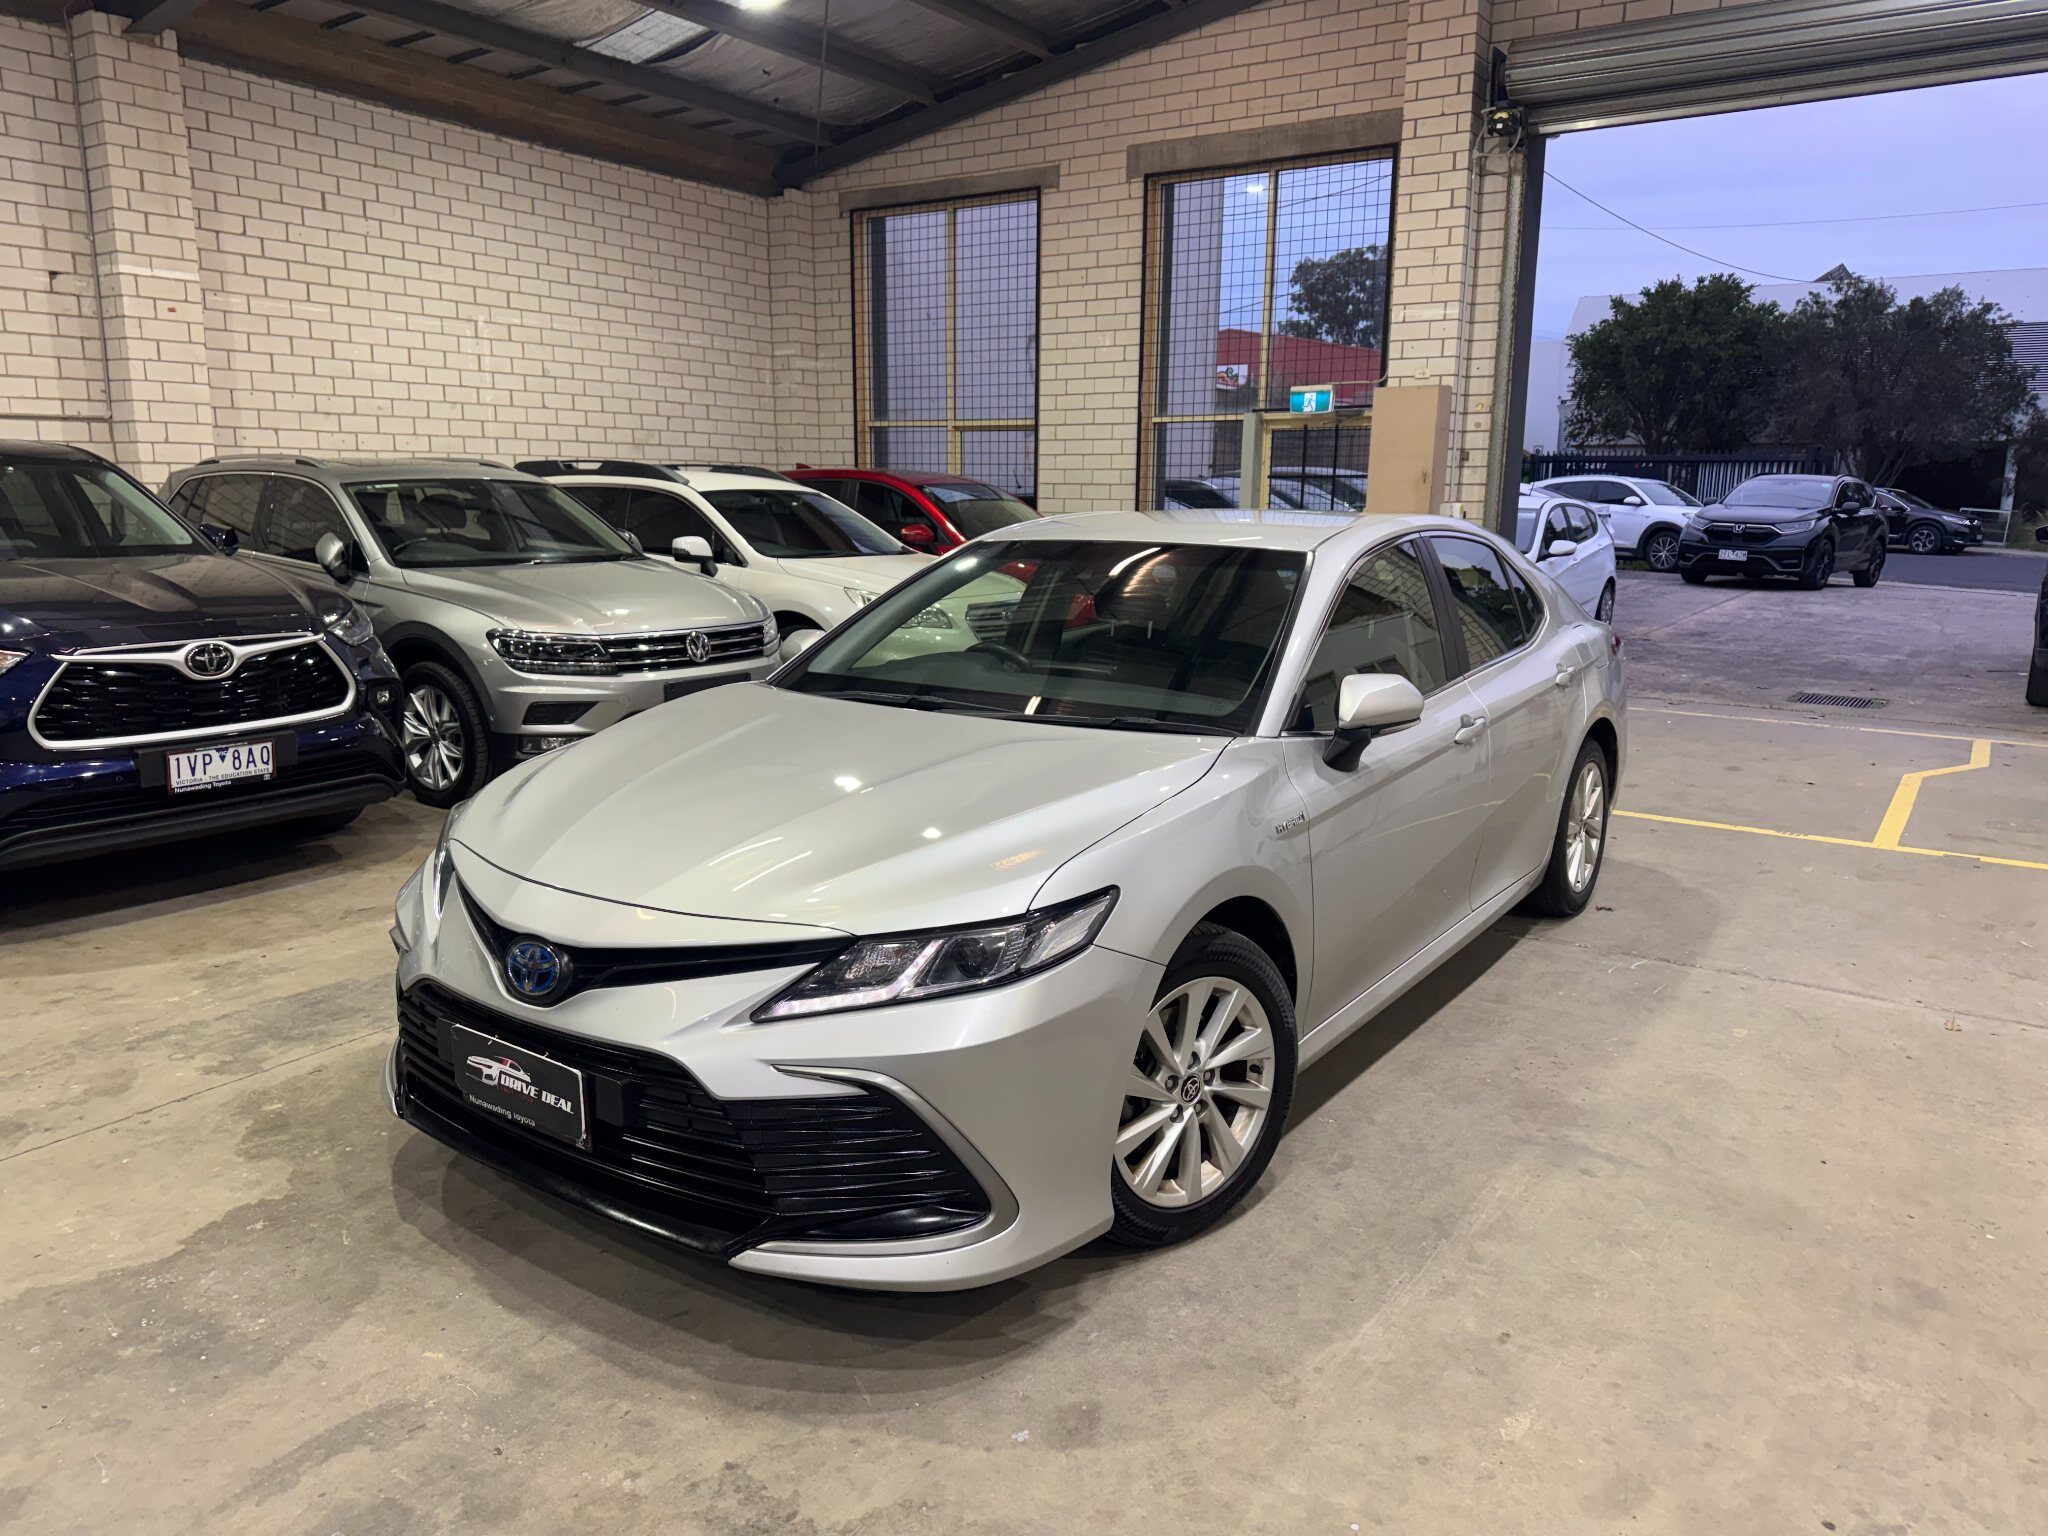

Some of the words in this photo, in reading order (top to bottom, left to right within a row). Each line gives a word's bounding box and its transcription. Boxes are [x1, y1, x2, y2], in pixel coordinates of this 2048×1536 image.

[174, 753, 213, 779] 1VP
[232, 745, 271, 771] 8AQ
[174, 781, 212, 794] Nunawading
[213, 779, 232, 788] Toyota
[175, 777, 203, 786] VICTORIA
[221, 770, 252, 780] EDUCATION
[253, 767, 270, 775] STATE
[469, 1093, 512, 1119] Nunawading
[500, 1073, 540, 1099] DRIVE
[541, 1089, 575, 1115] DEAL
